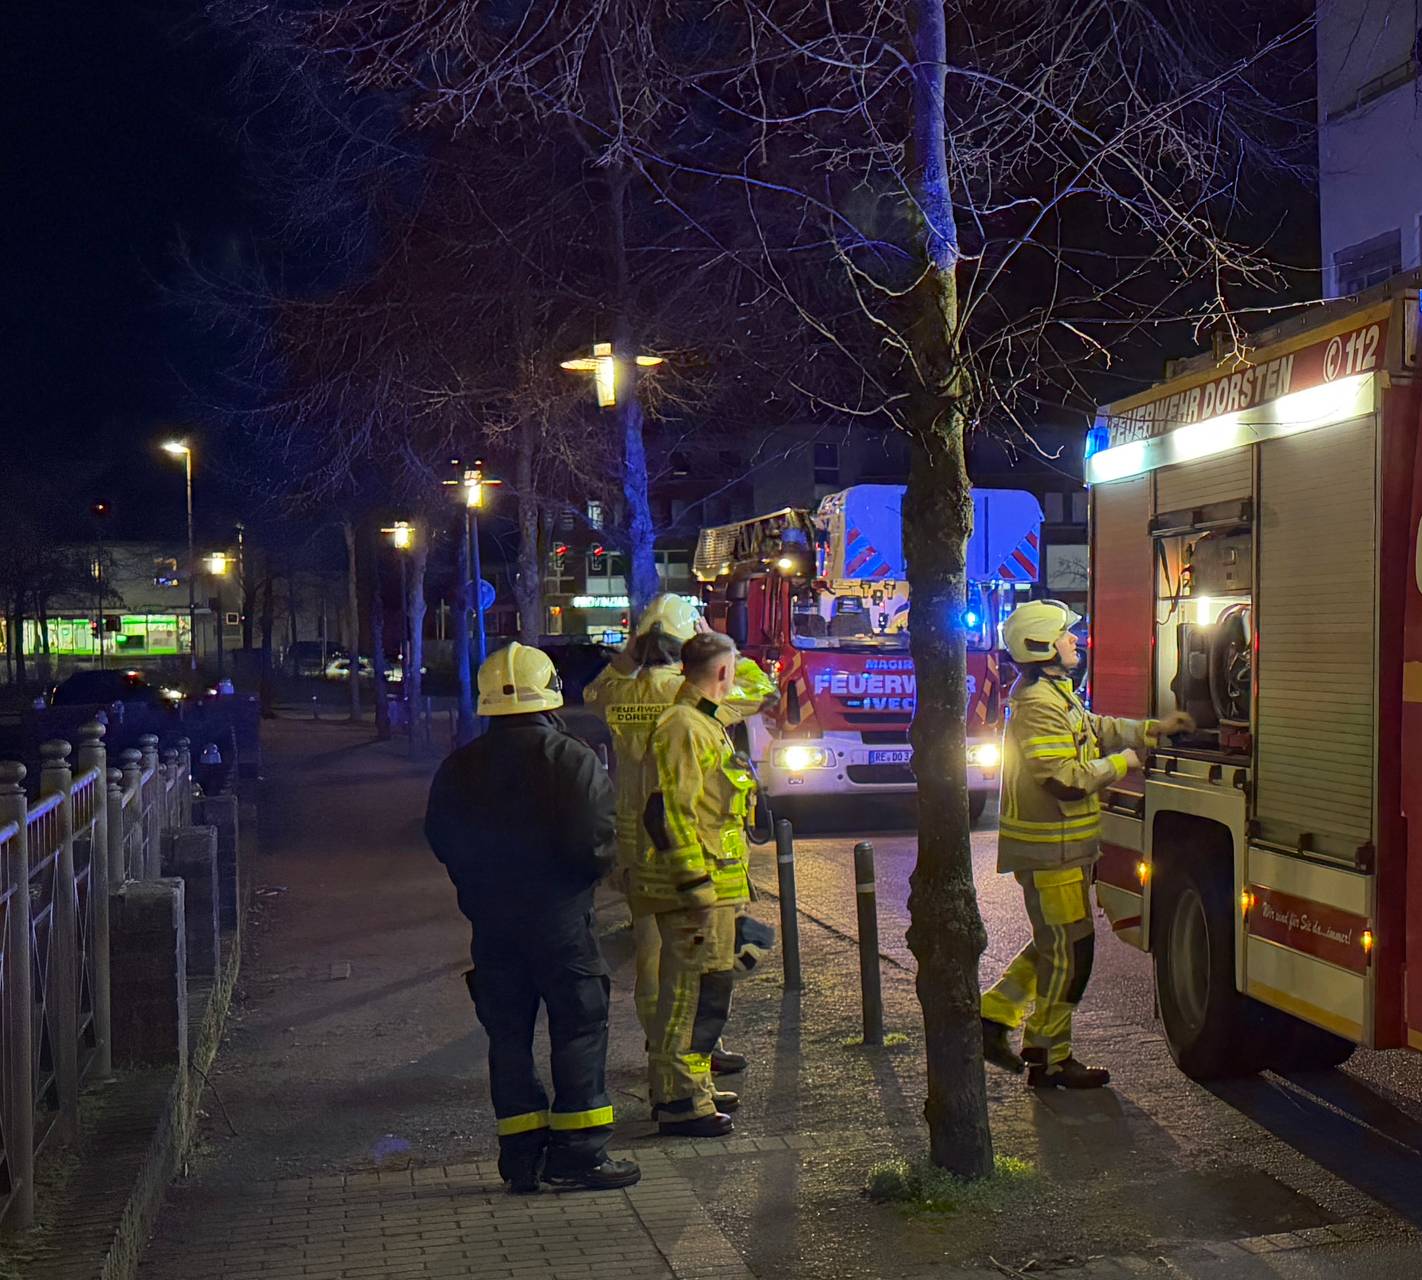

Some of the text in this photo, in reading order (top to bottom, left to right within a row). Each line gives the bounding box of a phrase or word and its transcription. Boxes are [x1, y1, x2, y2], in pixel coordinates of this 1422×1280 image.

[1109, 324, 1380, 447] FEUERWEHR DORSTEN 112
[864, 658, 913, 670] MAGIR
[863, 697, 914, 711] IVEC
